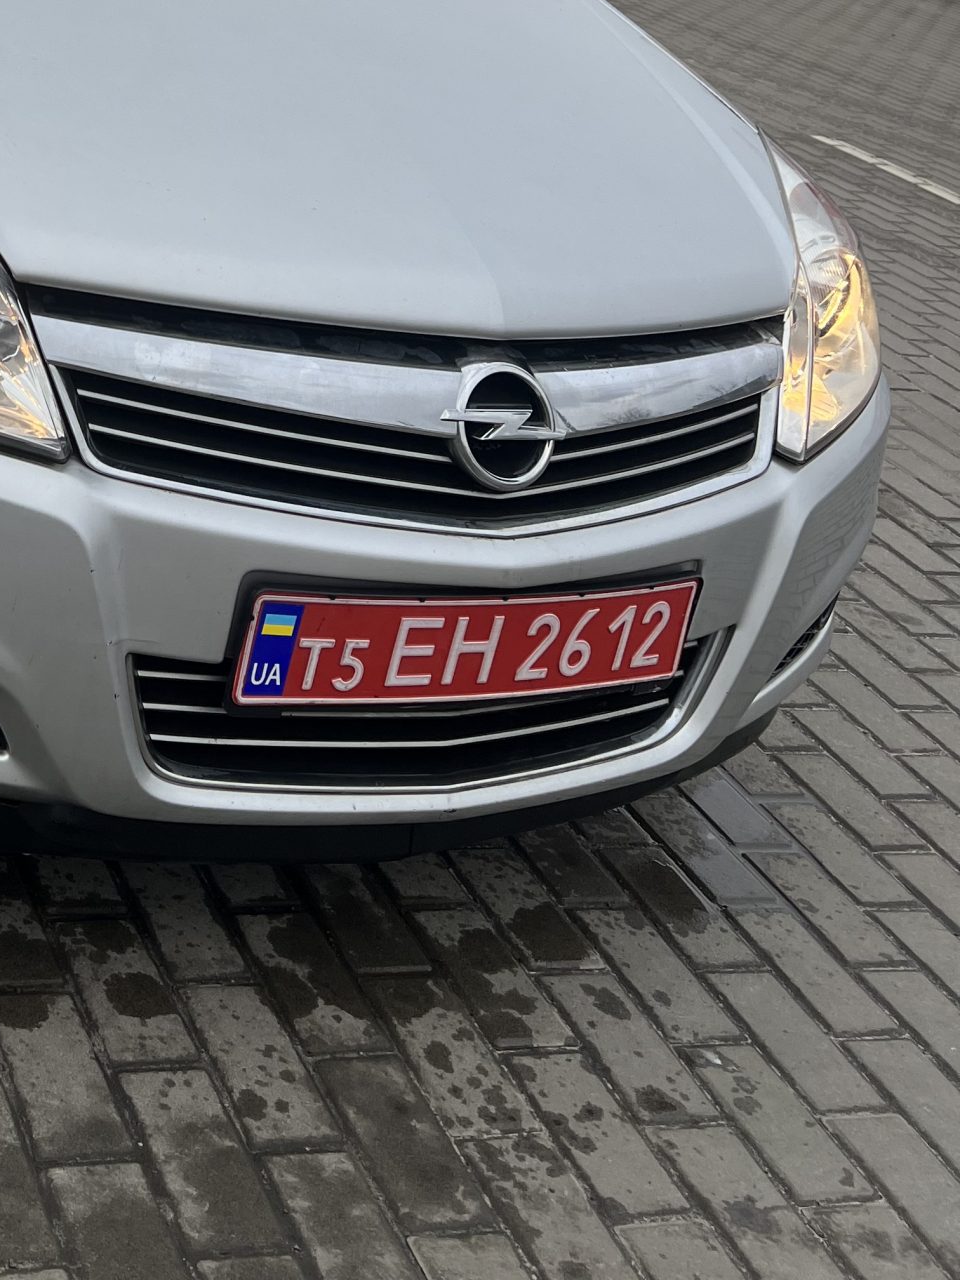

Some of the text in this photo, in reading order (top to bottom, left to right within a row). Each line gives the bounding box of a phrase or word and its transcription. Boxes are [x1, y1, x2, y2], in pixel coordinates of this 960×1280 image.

[249, 662, 281, 687] UA
[298, 600, 671, 692] T5 EH 2612
